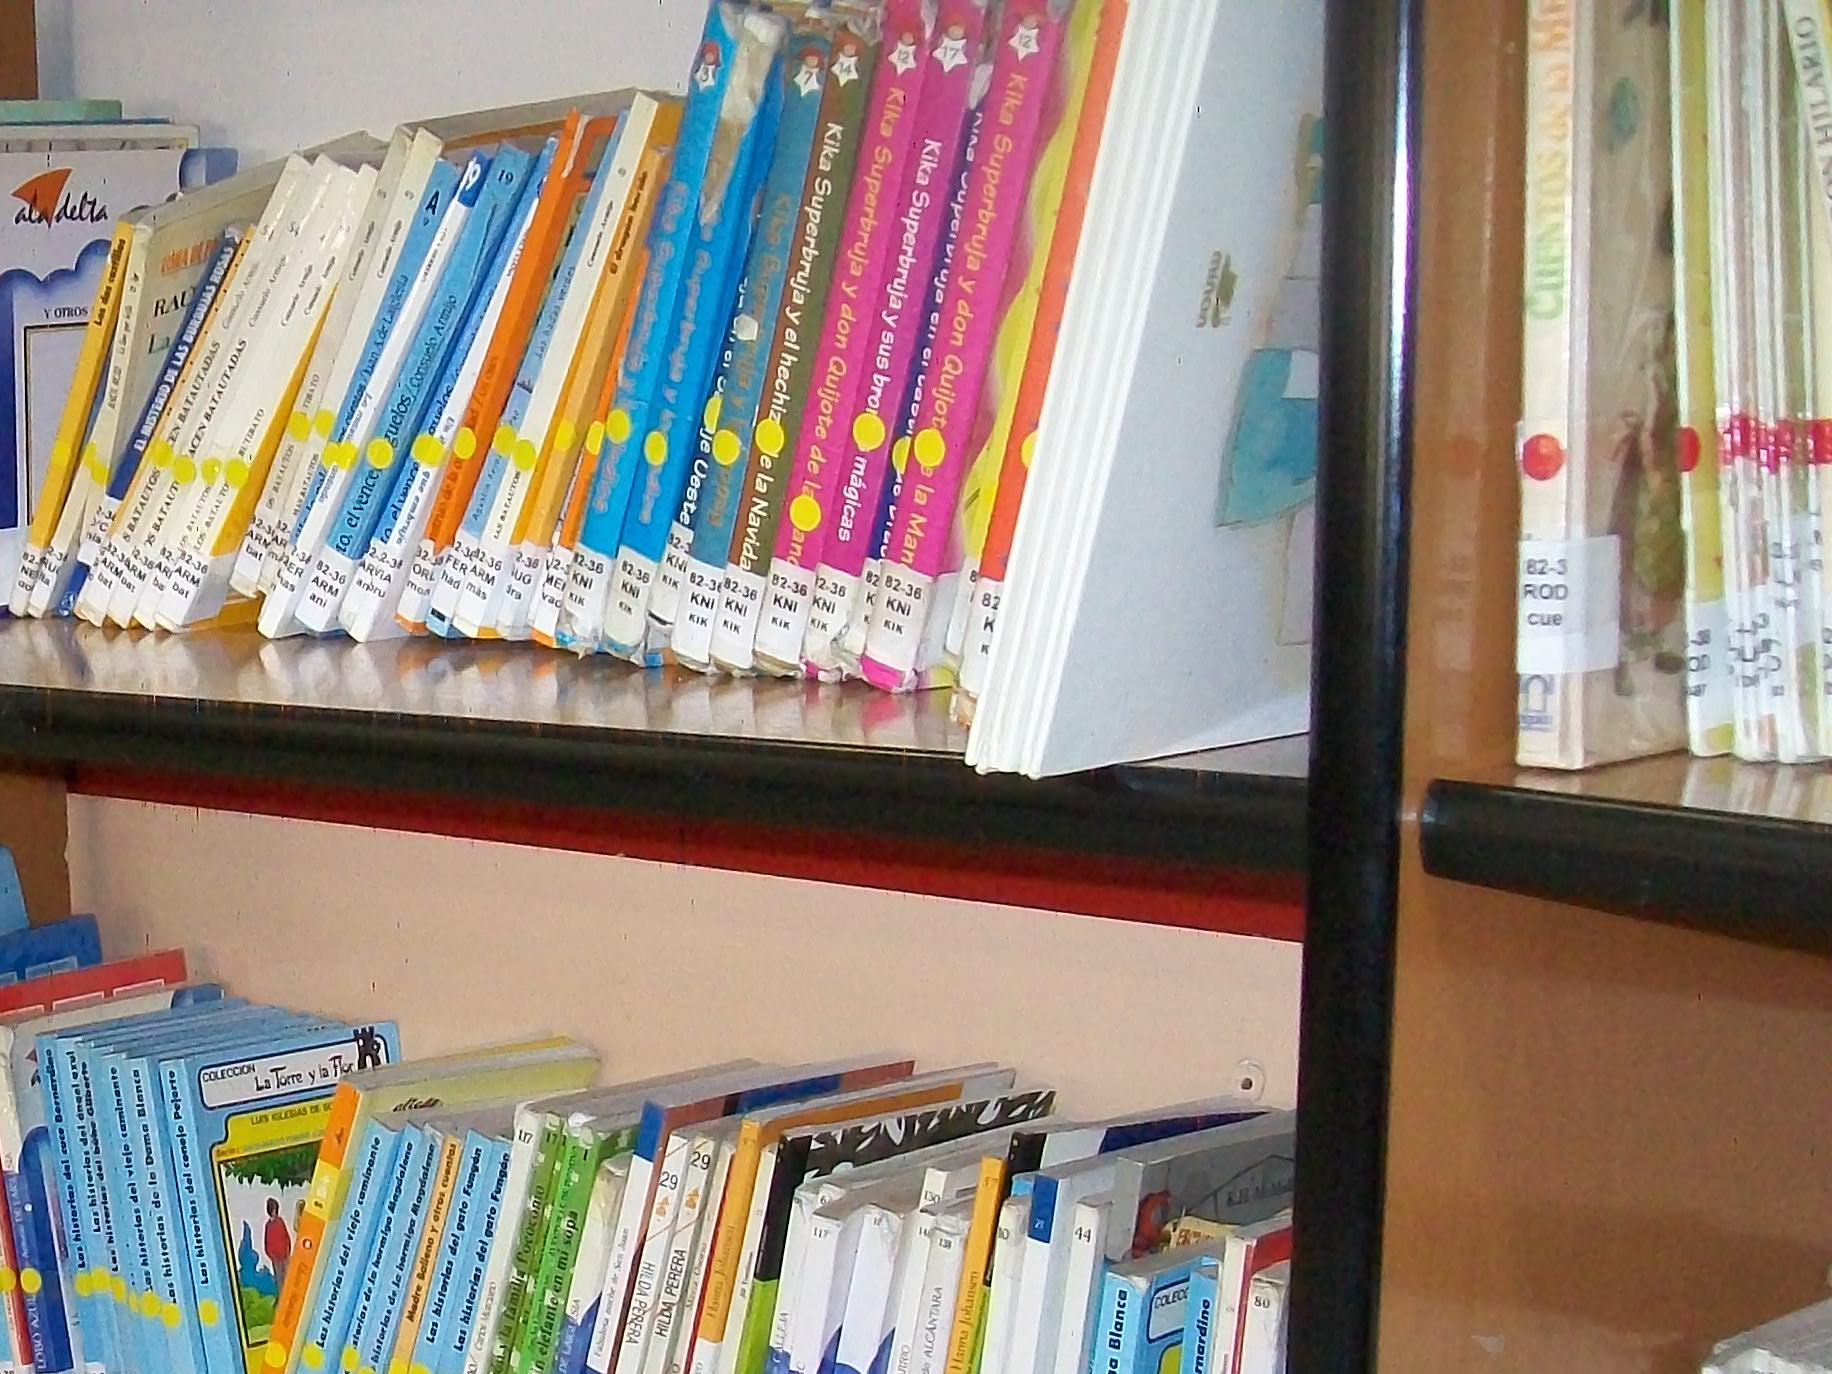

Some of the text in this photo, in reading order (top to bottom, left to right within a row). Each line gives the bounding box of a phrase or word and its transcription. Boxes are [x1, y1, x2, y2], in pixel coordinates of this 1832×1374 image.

[999, 73, 1026, 125] Kika
[819, 122, 845, 173] Kika
[55, 191, 110, 226] delta
[963, 136, 1013, 273] Superbruja
[791, 174, 833, 312] Superbruja
[807, 87, 905, 477] Kika Superbruja y don Quijote de
[958, 276, 974, 292] y
[54, 306, 88, 319] OTROS
[786, 311, 802, 328] y
[949, 298, 969, 347] don
[838, 137, 942, 543] Kika Superbruja y sus mágicas
[205, 338, 248, 423] BATAUTADAS
[768, 352, 792, 423] hechiz
[931, 353, 964, 437] Quijot
[739, 498, 771, 571] Navida
[175, 566, 200, 588] ARM
[311, 577, 339, 599] ARM
[723, 577, 757, 602] 82-36
[770, 574, 808, 597] 82-36
[884, 574, 922, 600] 82-36
[773, 595, 799, 614] KNI
[886, 595, 912, 617] KNI
[1523, 583, 1569, 602] ROD
[724, 597, 748, 618] KNI
[1526, 611, 1563, 627] cue
[255, 1075, 271, 1092] La
[269, 1066, 303, 1089] Torre
[308, 1070, 316, 1085] y
[318, 1063, 329, 1079] la
[357, 1136, 381, 1207] caminante
[690, 1152, 711, 1171] 29
[659, 1172, 678, 1190] 29
[1075, 1226, 1091, 1243] 44
[665, 1249, 689, 1303] PERERA
[1108, 1290, 1128, 1350] Blanca
